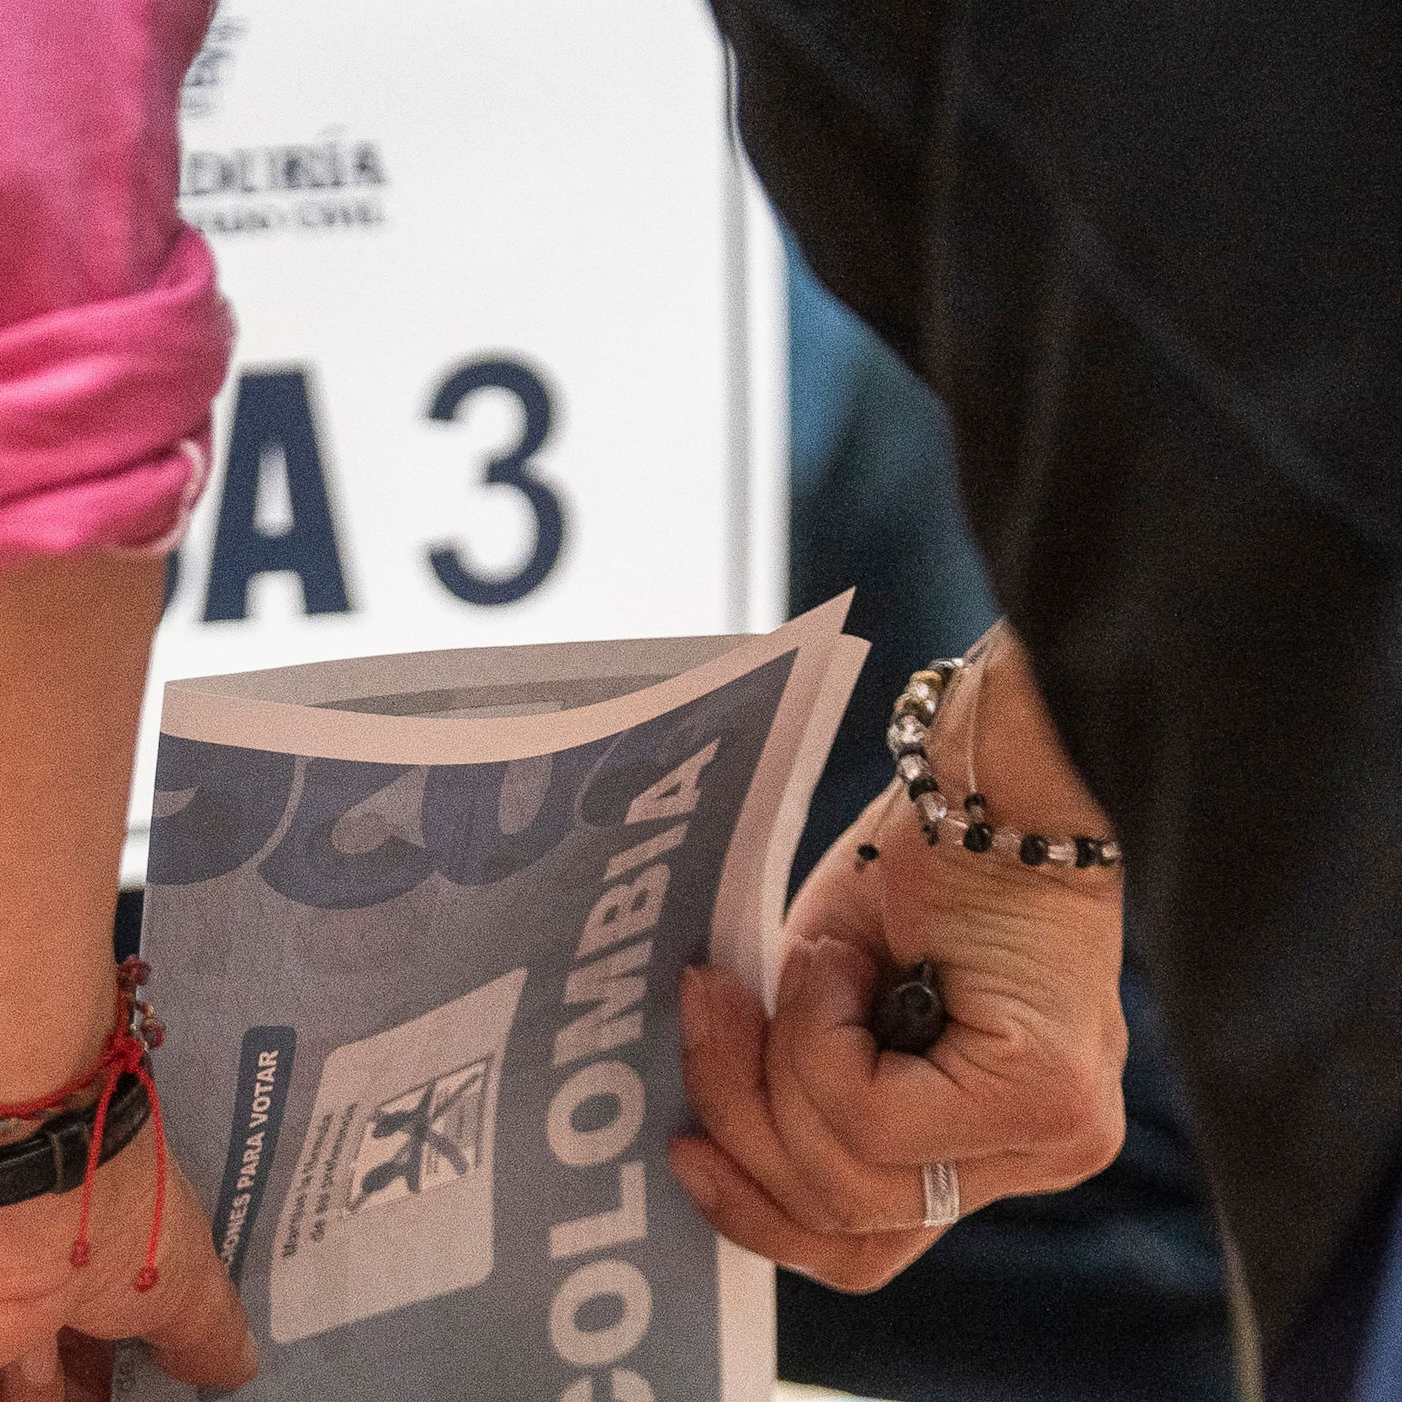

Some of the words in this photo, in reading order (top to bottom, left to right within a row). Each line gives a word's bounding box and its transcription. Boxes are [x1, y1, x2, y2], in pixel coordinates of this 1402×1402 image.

[424, 350, 569, 610] 3
[248, 1049, 280, 1130] VOTAR
[236, 1131, 265, 1191] PARA
